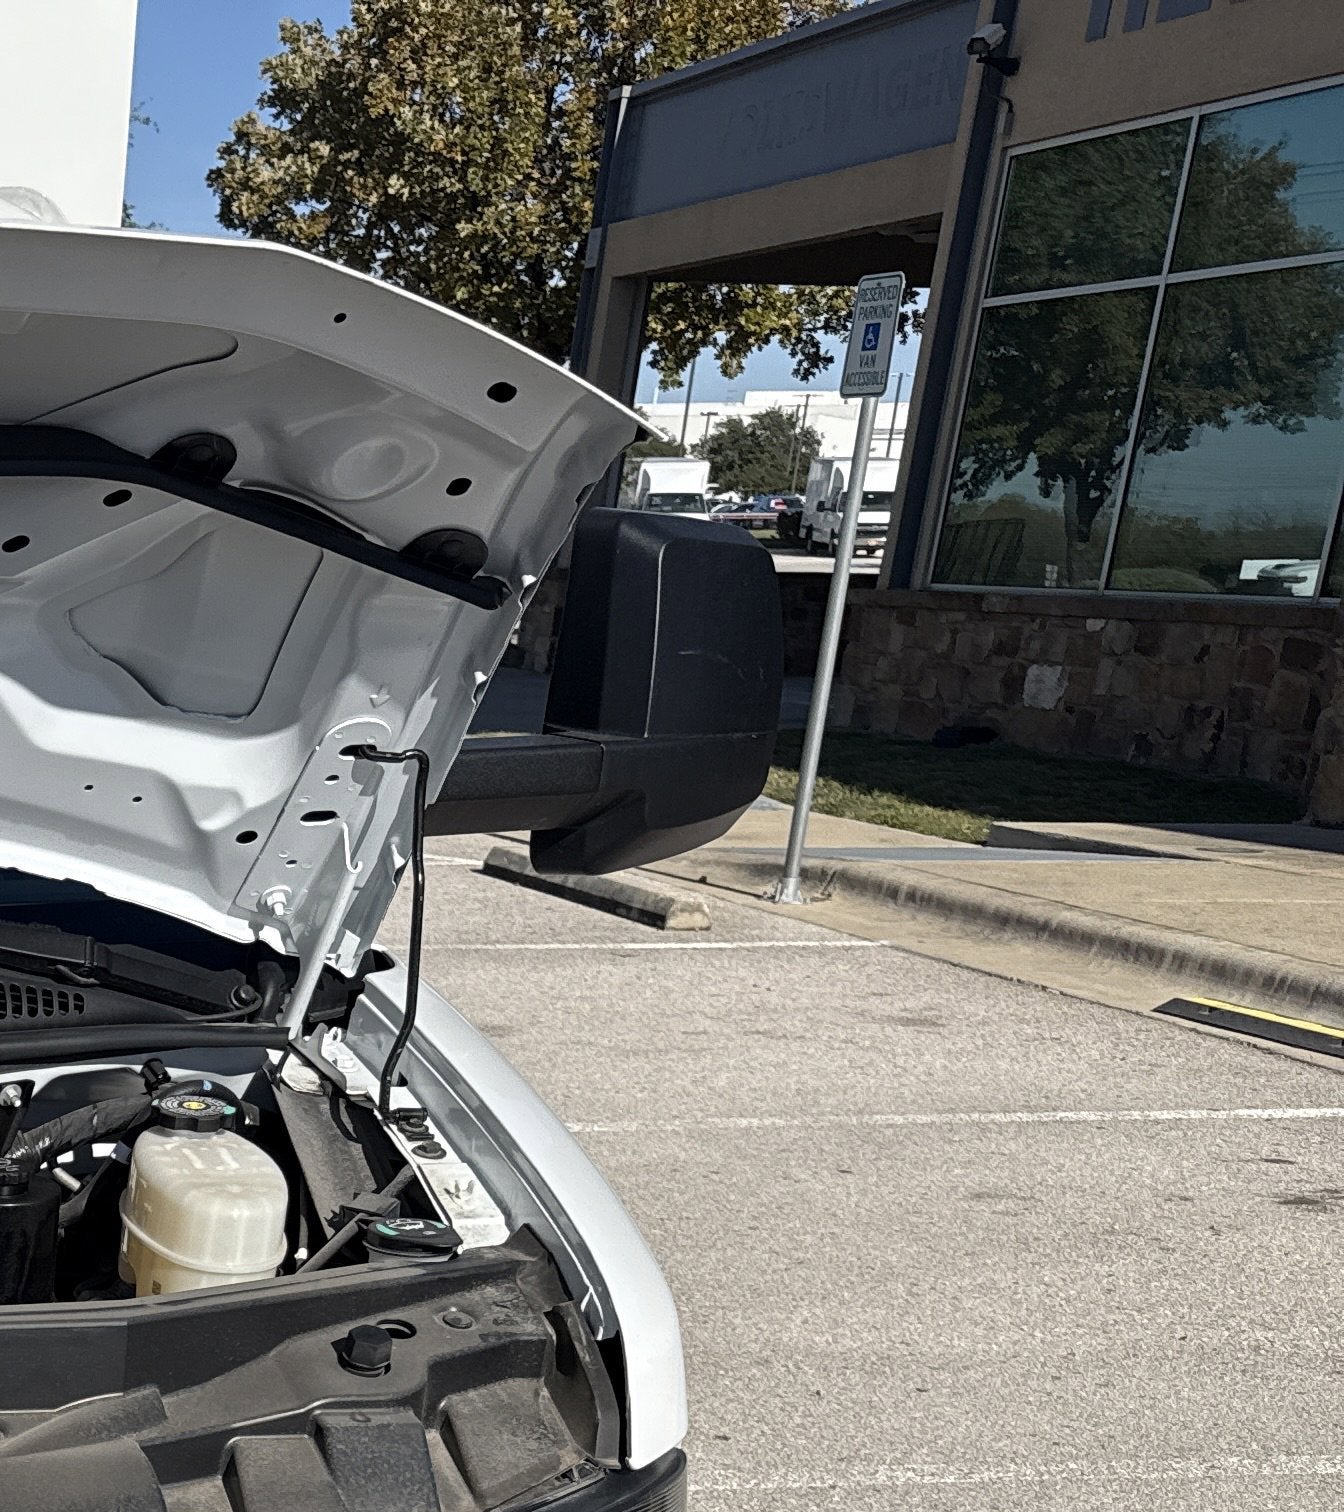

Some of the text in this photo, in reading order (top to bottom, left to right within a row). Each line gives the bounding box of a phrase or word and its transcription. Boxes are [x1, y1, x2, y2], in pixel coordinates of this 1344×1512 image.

[860, 284, 899, 303] RESERVED
[858, 304, 893, 321] PARKING
[859, 353, 877, 368] VAN
[846, 370, 886, 387] ACCESSIBLE
